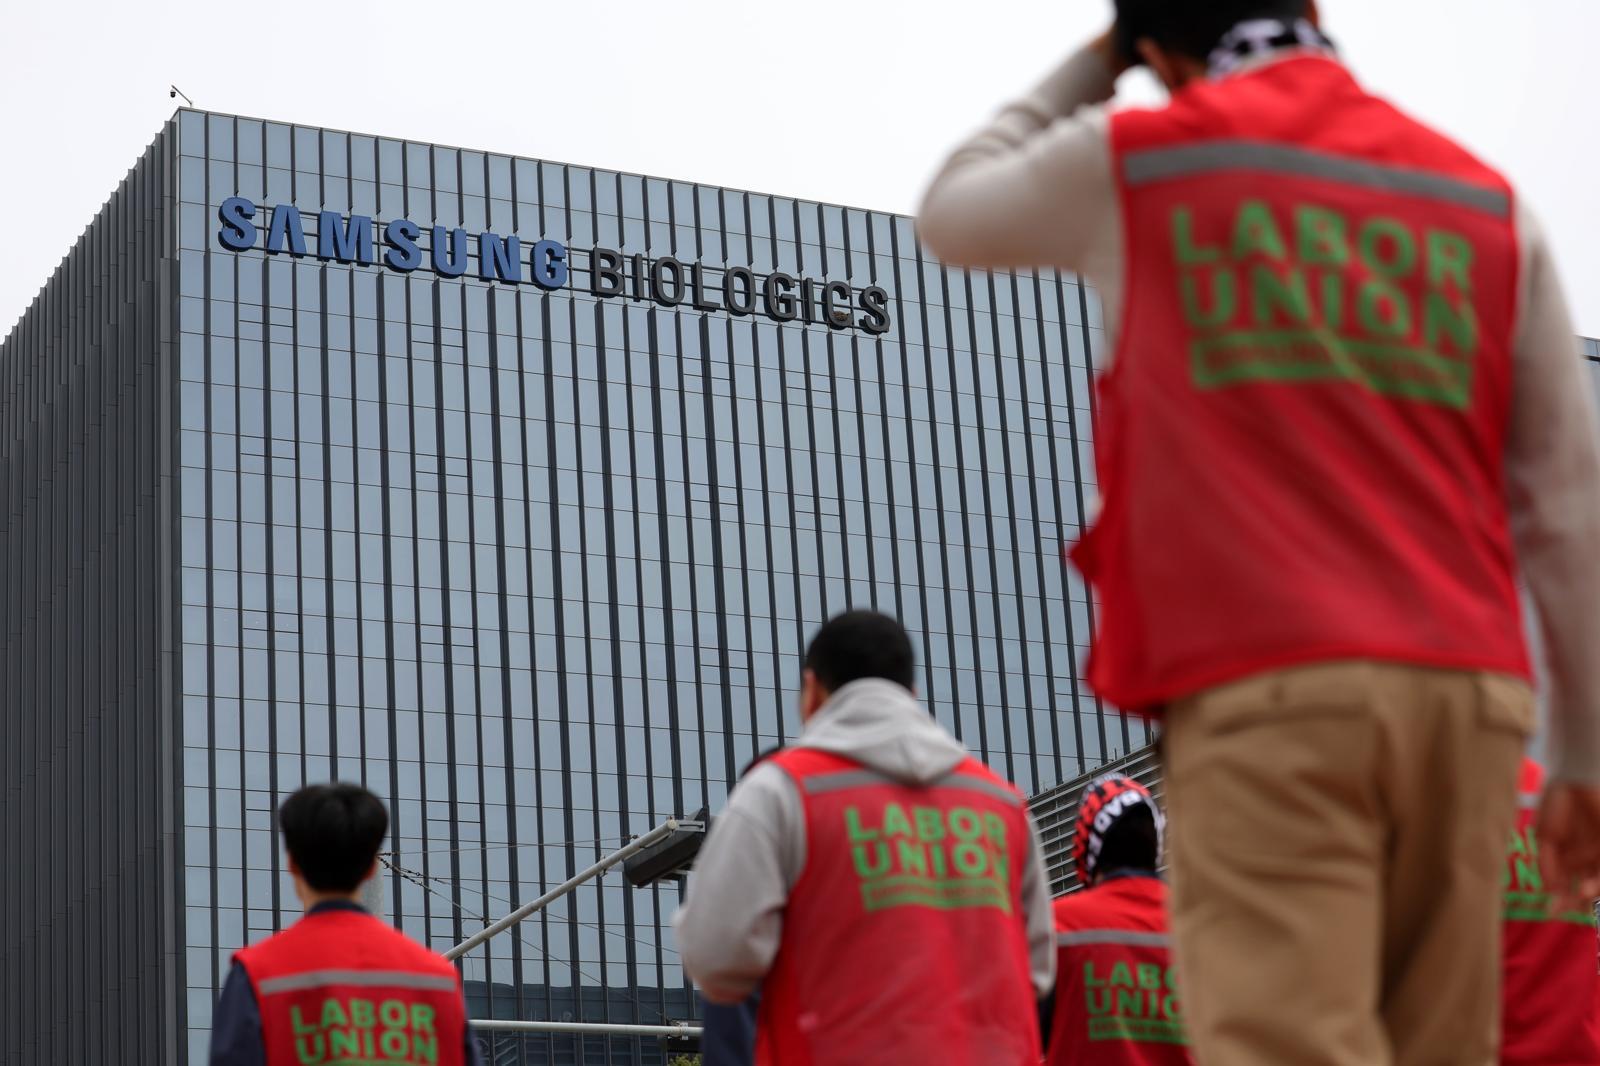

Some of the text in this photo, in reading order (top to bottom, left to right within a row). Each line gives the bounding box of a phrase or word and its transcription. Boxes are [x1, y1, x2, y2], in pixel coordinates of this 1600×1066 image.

[219, 197, 891, 334] SAMSUNG BIOLOGICS
[1171, 200, 1473, 290] LABOR
[1181, 265, 1478, 354] UNION
[845, 803, 1006, 847] LABOR
[290, 998, 435, 1034] LABOR
[1085, 986, 1184, 1020] UNIO
[296, 1029, 438, 1065] UNION
